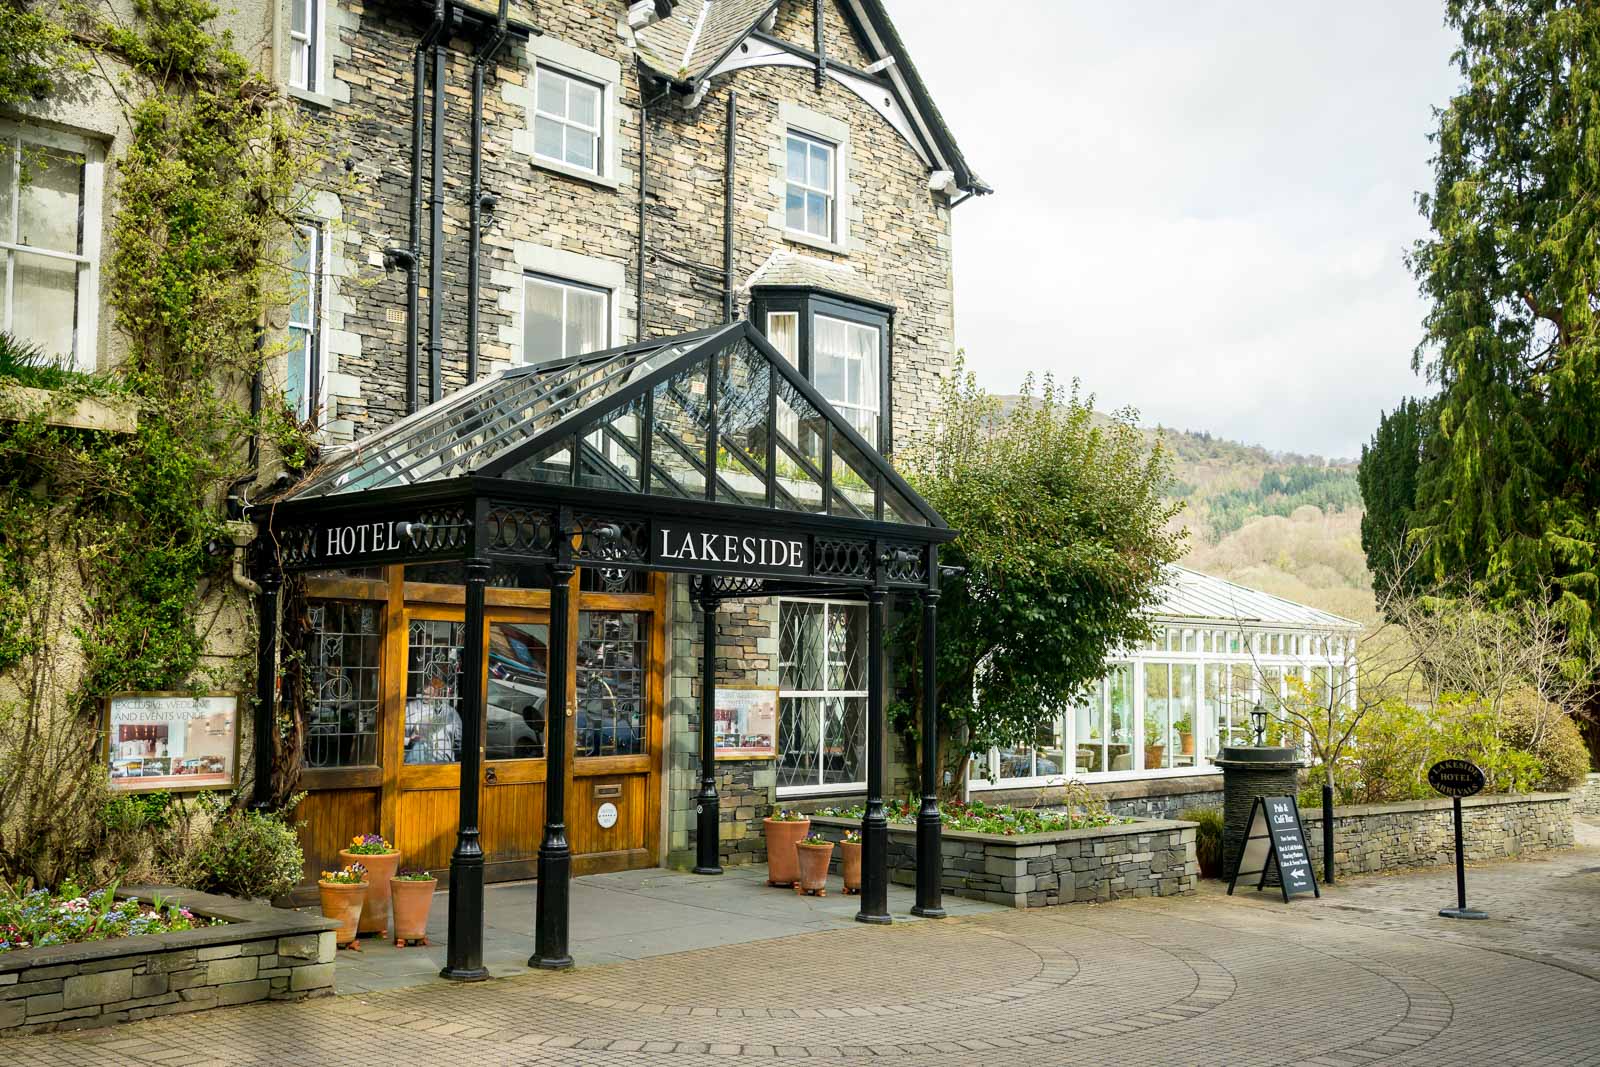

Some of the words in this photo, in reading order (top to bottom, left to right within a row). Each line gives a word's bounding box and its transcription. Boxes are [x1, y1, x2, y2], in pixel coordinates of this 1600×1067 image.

[326, 521, 400, 556] HOTEL
[660, 529, 804, 568] LAKESIDE
[115, 700, 163, 710] EXCLUSIVE
[115, 712, 137, 721] AND
[140, 712, 174, 721] EVENTS
[177, 711, 206, 720] VENUE
[1432, 761, 1478, 777] LAKESIDE
[1440, 772, 1472, 782] HOTEL
[1436, 782, 1478, 796] ARRIVALS
